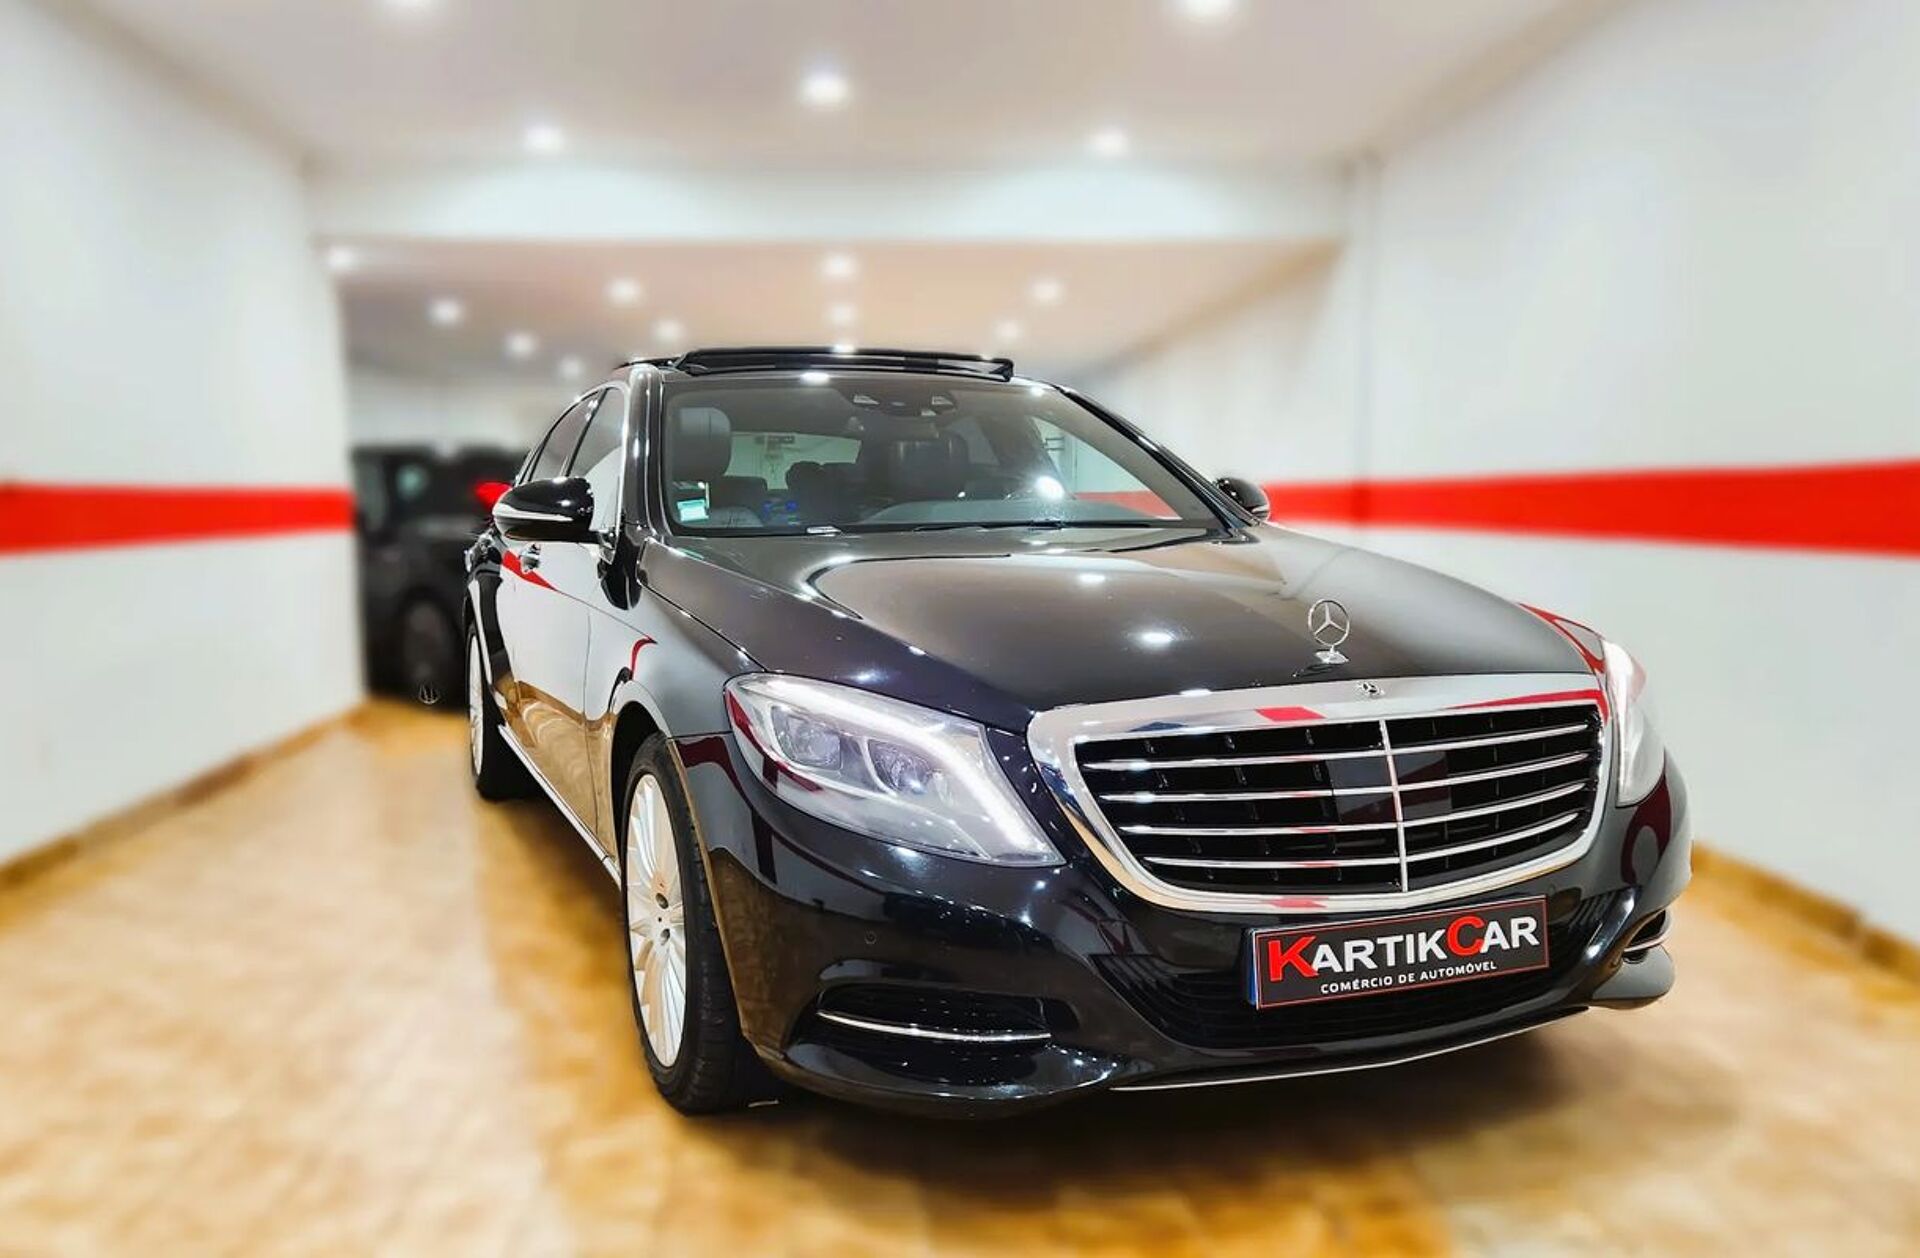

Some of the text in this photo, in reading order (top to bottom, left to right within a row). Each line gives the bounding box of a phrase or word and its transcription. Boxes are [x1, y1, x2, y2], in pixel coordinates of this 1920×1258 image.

[1268, 915, 1540, 982] KARTIKCAR
[1320, 960, 1497, 994] COMÉRCIO DE AUTOMÓVEL
